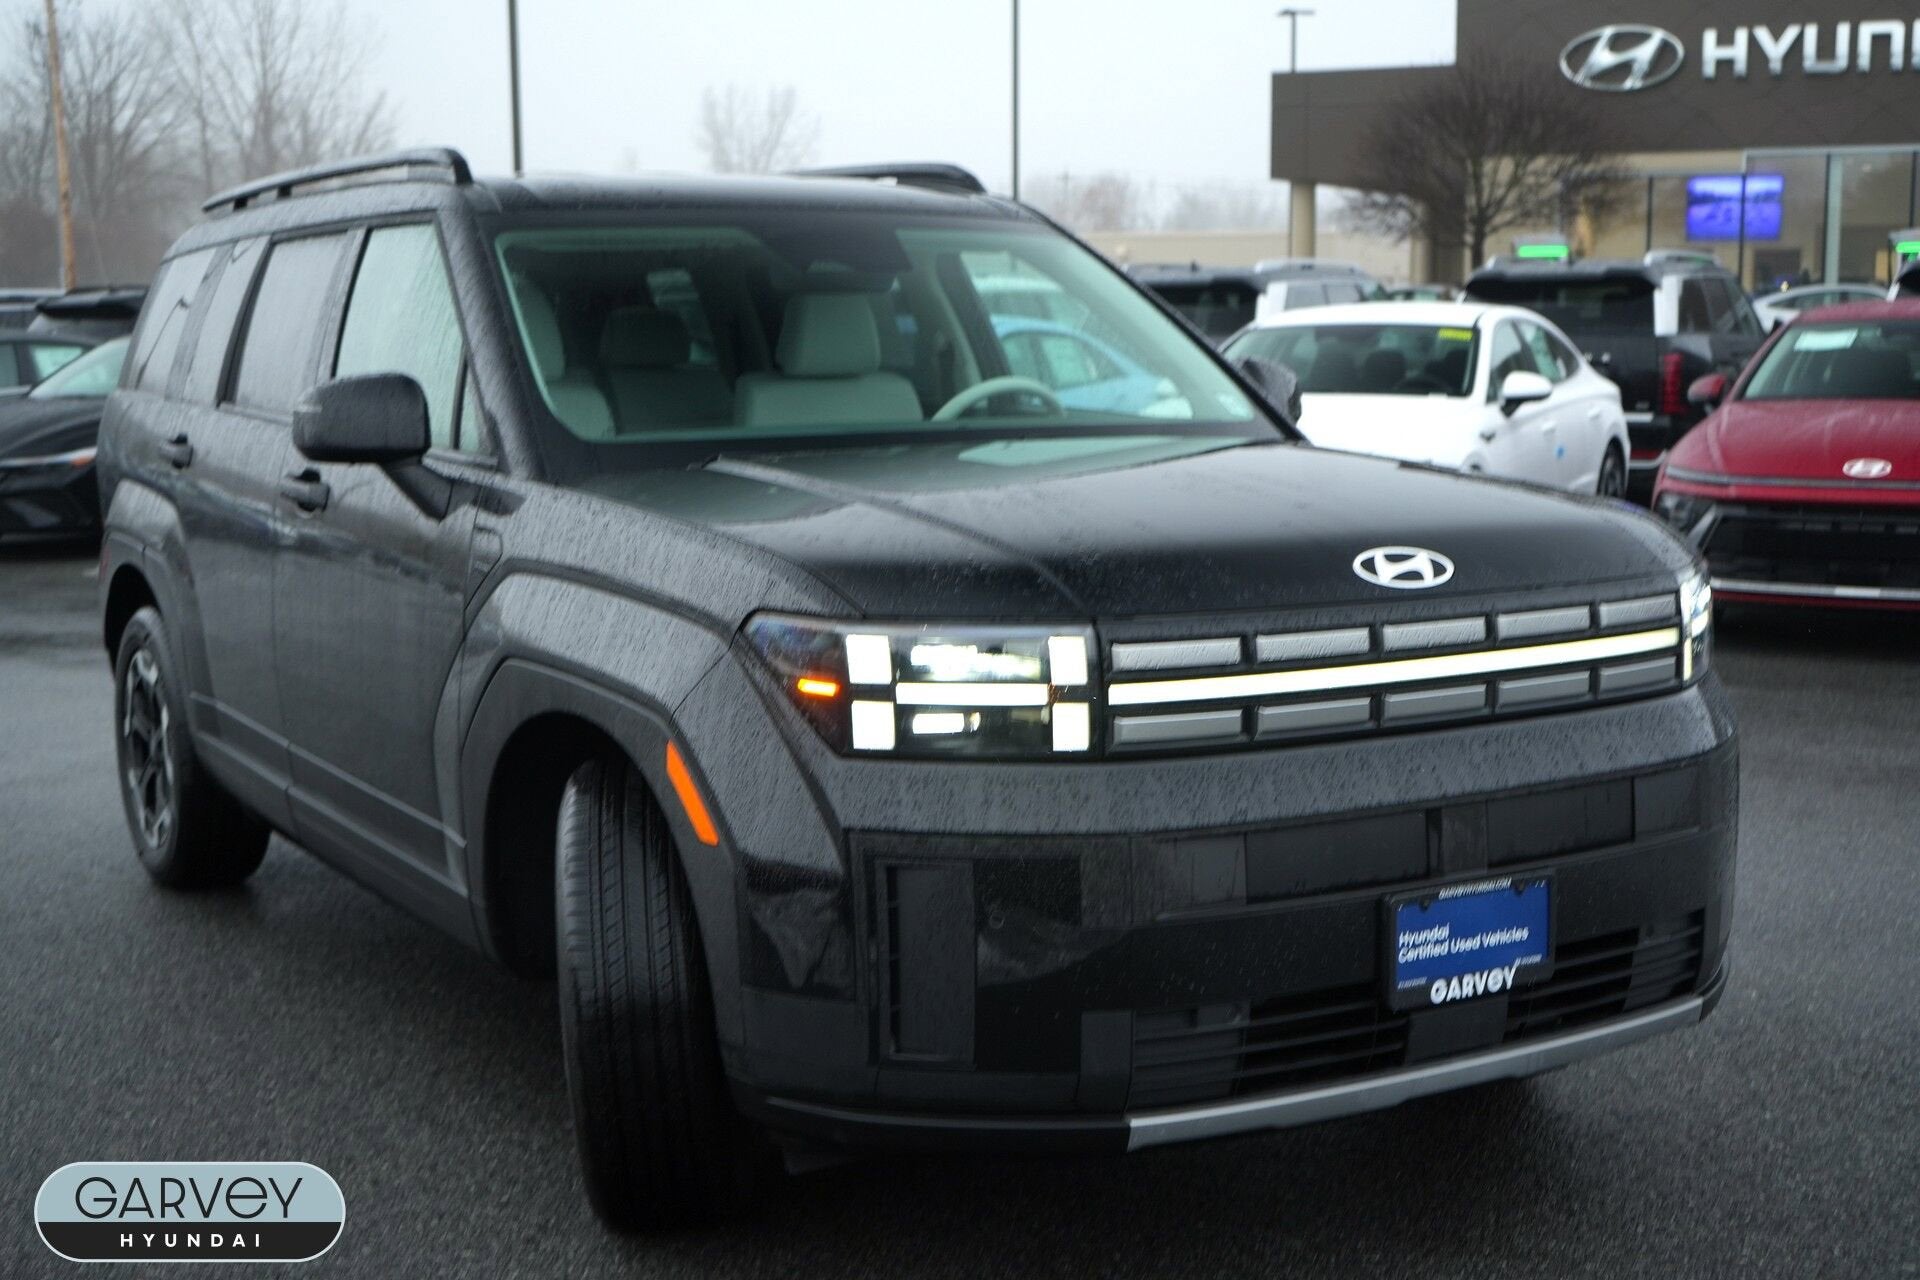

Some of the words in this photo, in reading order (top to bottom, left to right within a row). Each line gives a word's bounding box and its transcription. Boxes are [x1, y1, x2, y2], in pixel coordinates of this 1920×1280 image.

[1702, 18, 1920, 79] HYUN
[1398, 922, 1450, 948] Hyundai
[1398, 939, 1449, 964] Certified
[1450, 932, 1481, 954] Used
[1482, 925, 1529, 948] Vehicles
